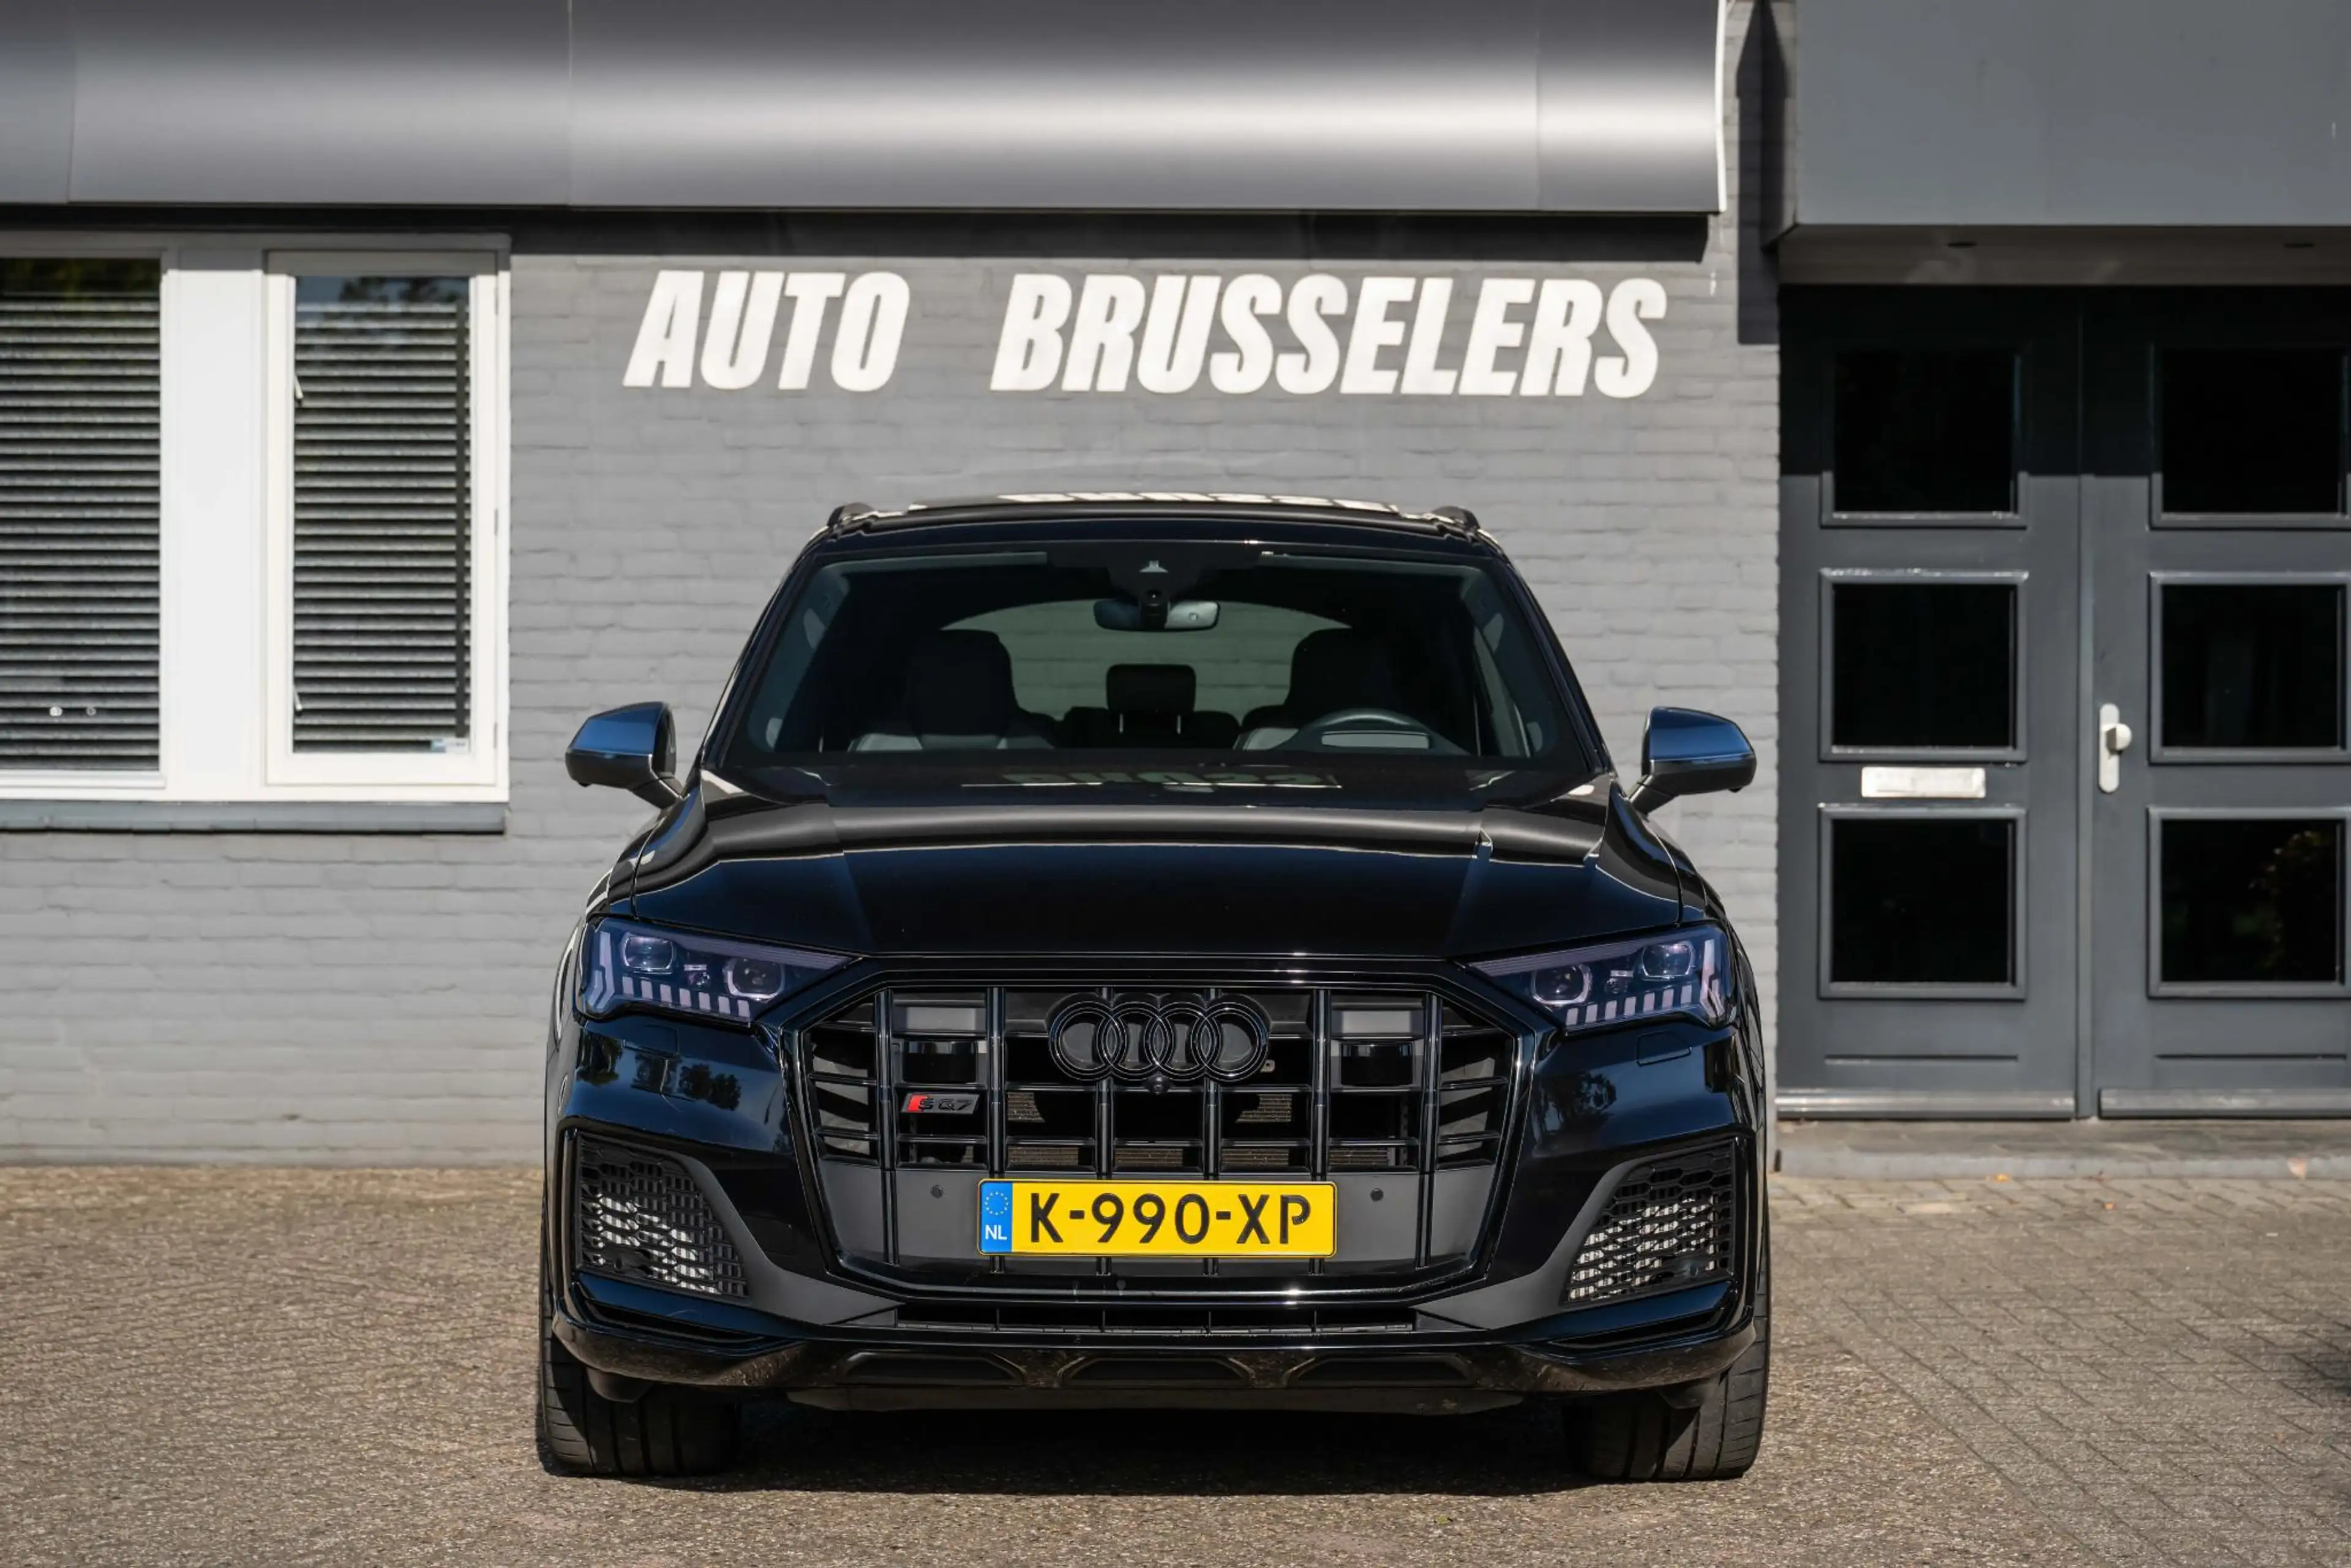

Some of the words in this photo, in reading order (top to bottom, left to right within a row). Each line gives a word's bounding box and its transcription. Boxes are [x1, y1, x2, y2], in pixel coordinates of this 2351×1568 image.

[623, 270, 910, 392] AUTO
[990, 273, 1667, 398] BRUSSELERS
[985, 1225, 1008, 1240] NL
[1030, 1193, 1311, 1245] K-990-XP
